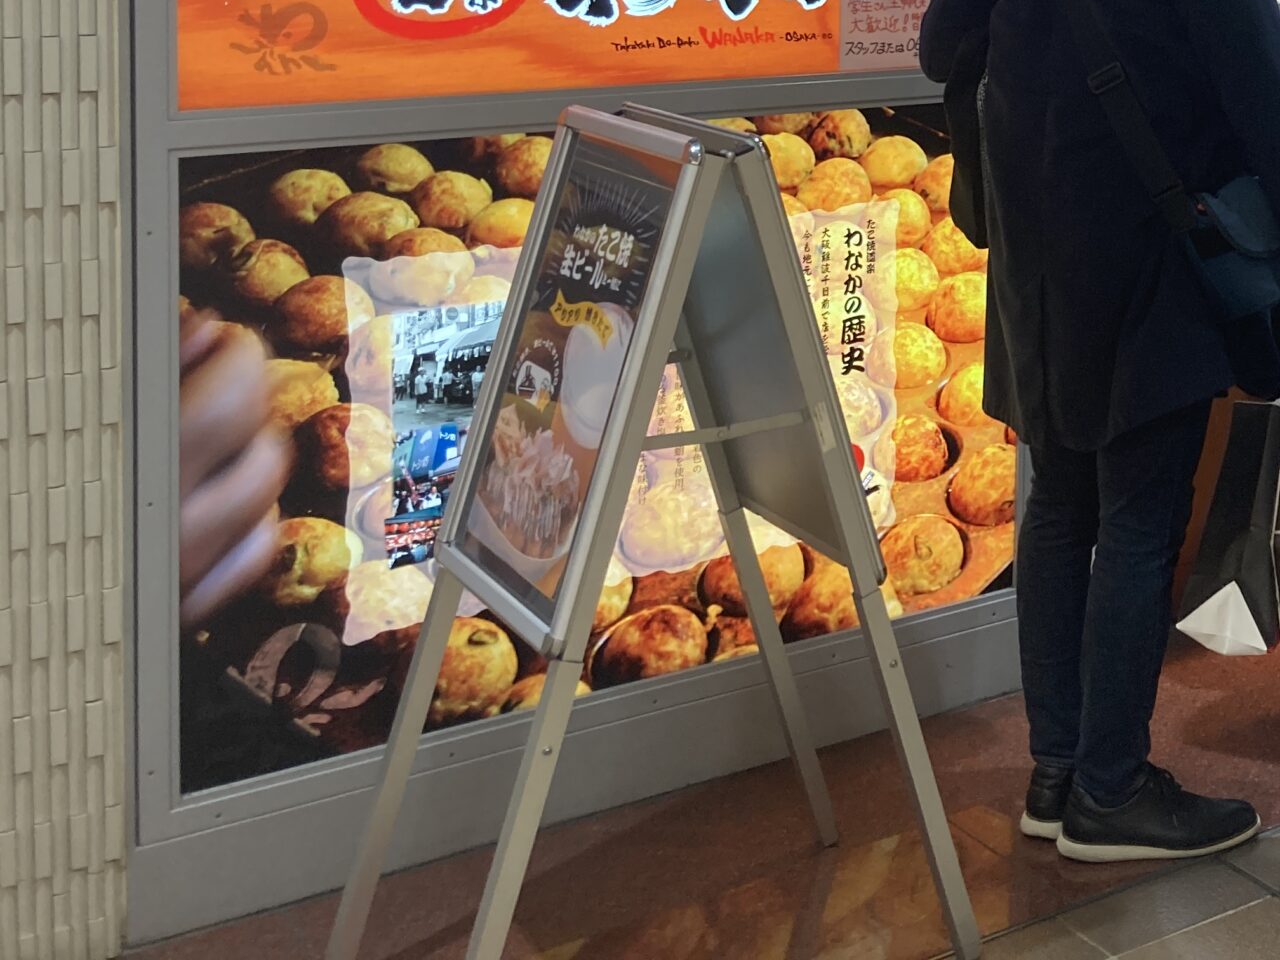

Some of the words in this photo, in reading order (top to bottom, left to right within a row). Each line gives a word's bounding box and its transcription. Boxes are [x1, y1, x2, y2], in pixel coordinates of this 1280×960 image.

[840, 227, 867, 376] わなかの歴史
